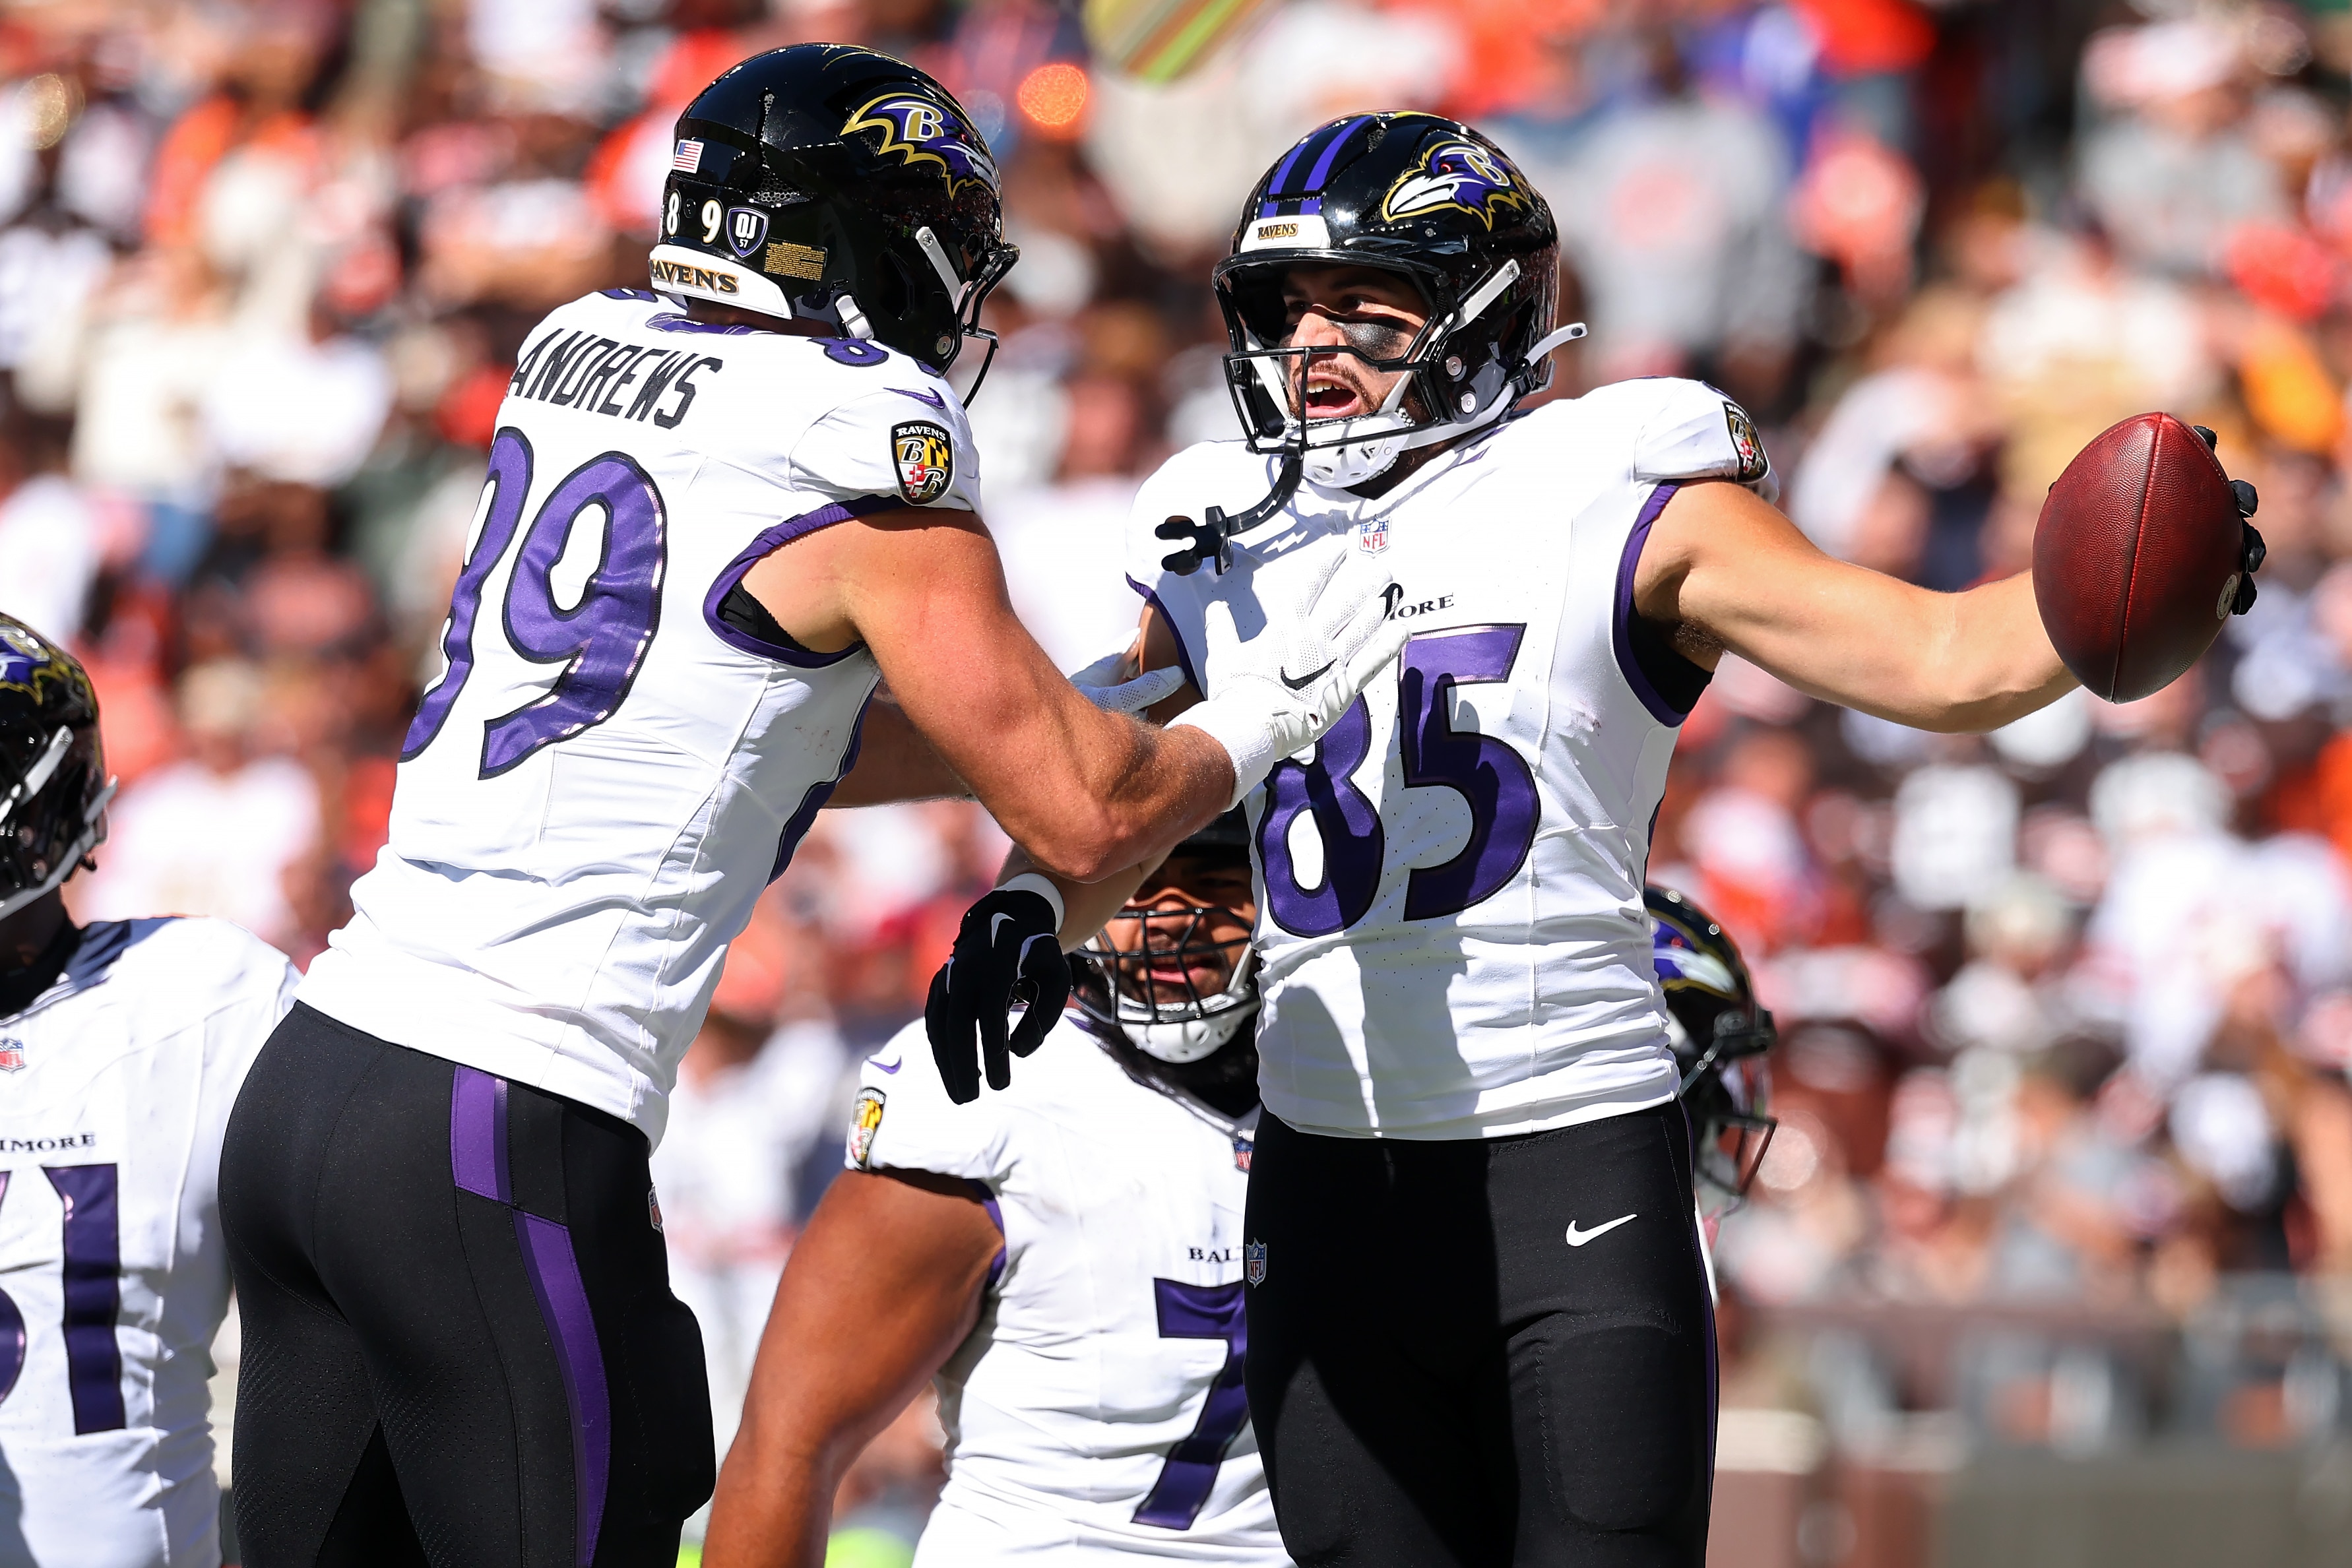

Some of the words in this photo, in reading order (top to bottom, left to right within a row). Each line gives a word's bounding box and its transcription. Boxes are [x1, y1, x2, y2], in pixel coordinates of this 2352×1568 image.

[666, 191, 680, 236] 8
[702, 199, 722, 244] 9
[1257, 223, 1299, 240] RAVENS
[739, 238, 748, 249] 57
[507, 329, 723, 430] ANDREWS
[896, 425, 947, 441] RAVENS
[897, 437, 926, 464] B
[1362, 532, 1386, 549] NFL
[1388, 592, 1454, 621] ORE
[1254, 621, 1541, 939] 85
[1250, 1260, 1263, 1279] NFL
